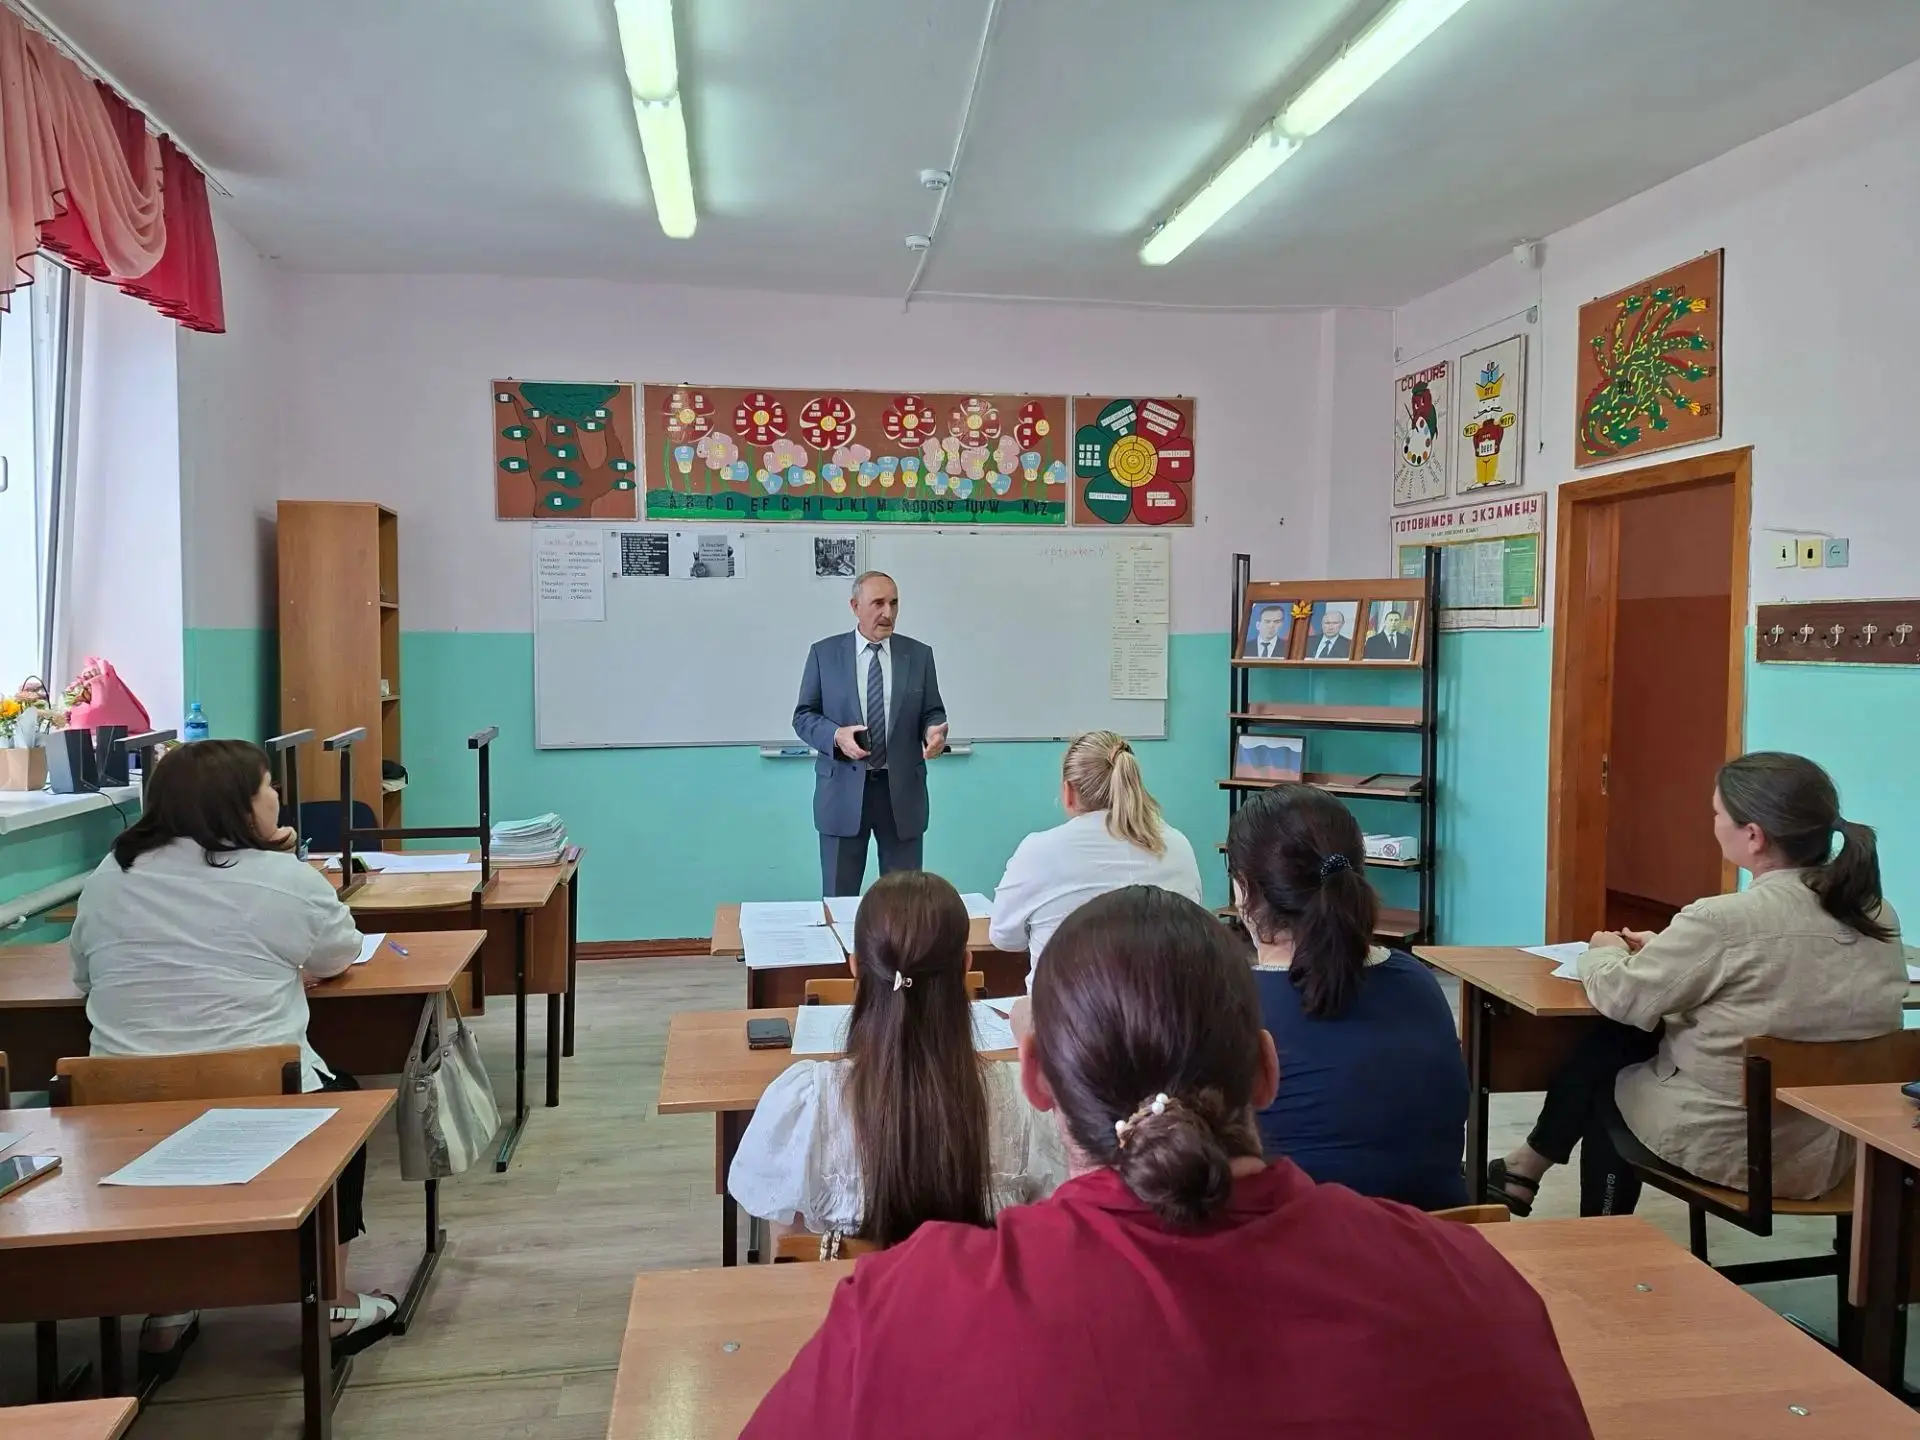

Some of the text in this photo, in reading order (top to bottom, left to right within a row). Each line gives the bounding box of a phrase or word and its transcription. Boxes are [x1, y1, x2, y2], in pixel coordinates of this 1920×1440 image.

[1401, 364, 1446, 392] COLOURS
[1395, 500, 1538, 533] ГОТОВИМСЯ К ЭКЗАМЕНУ
